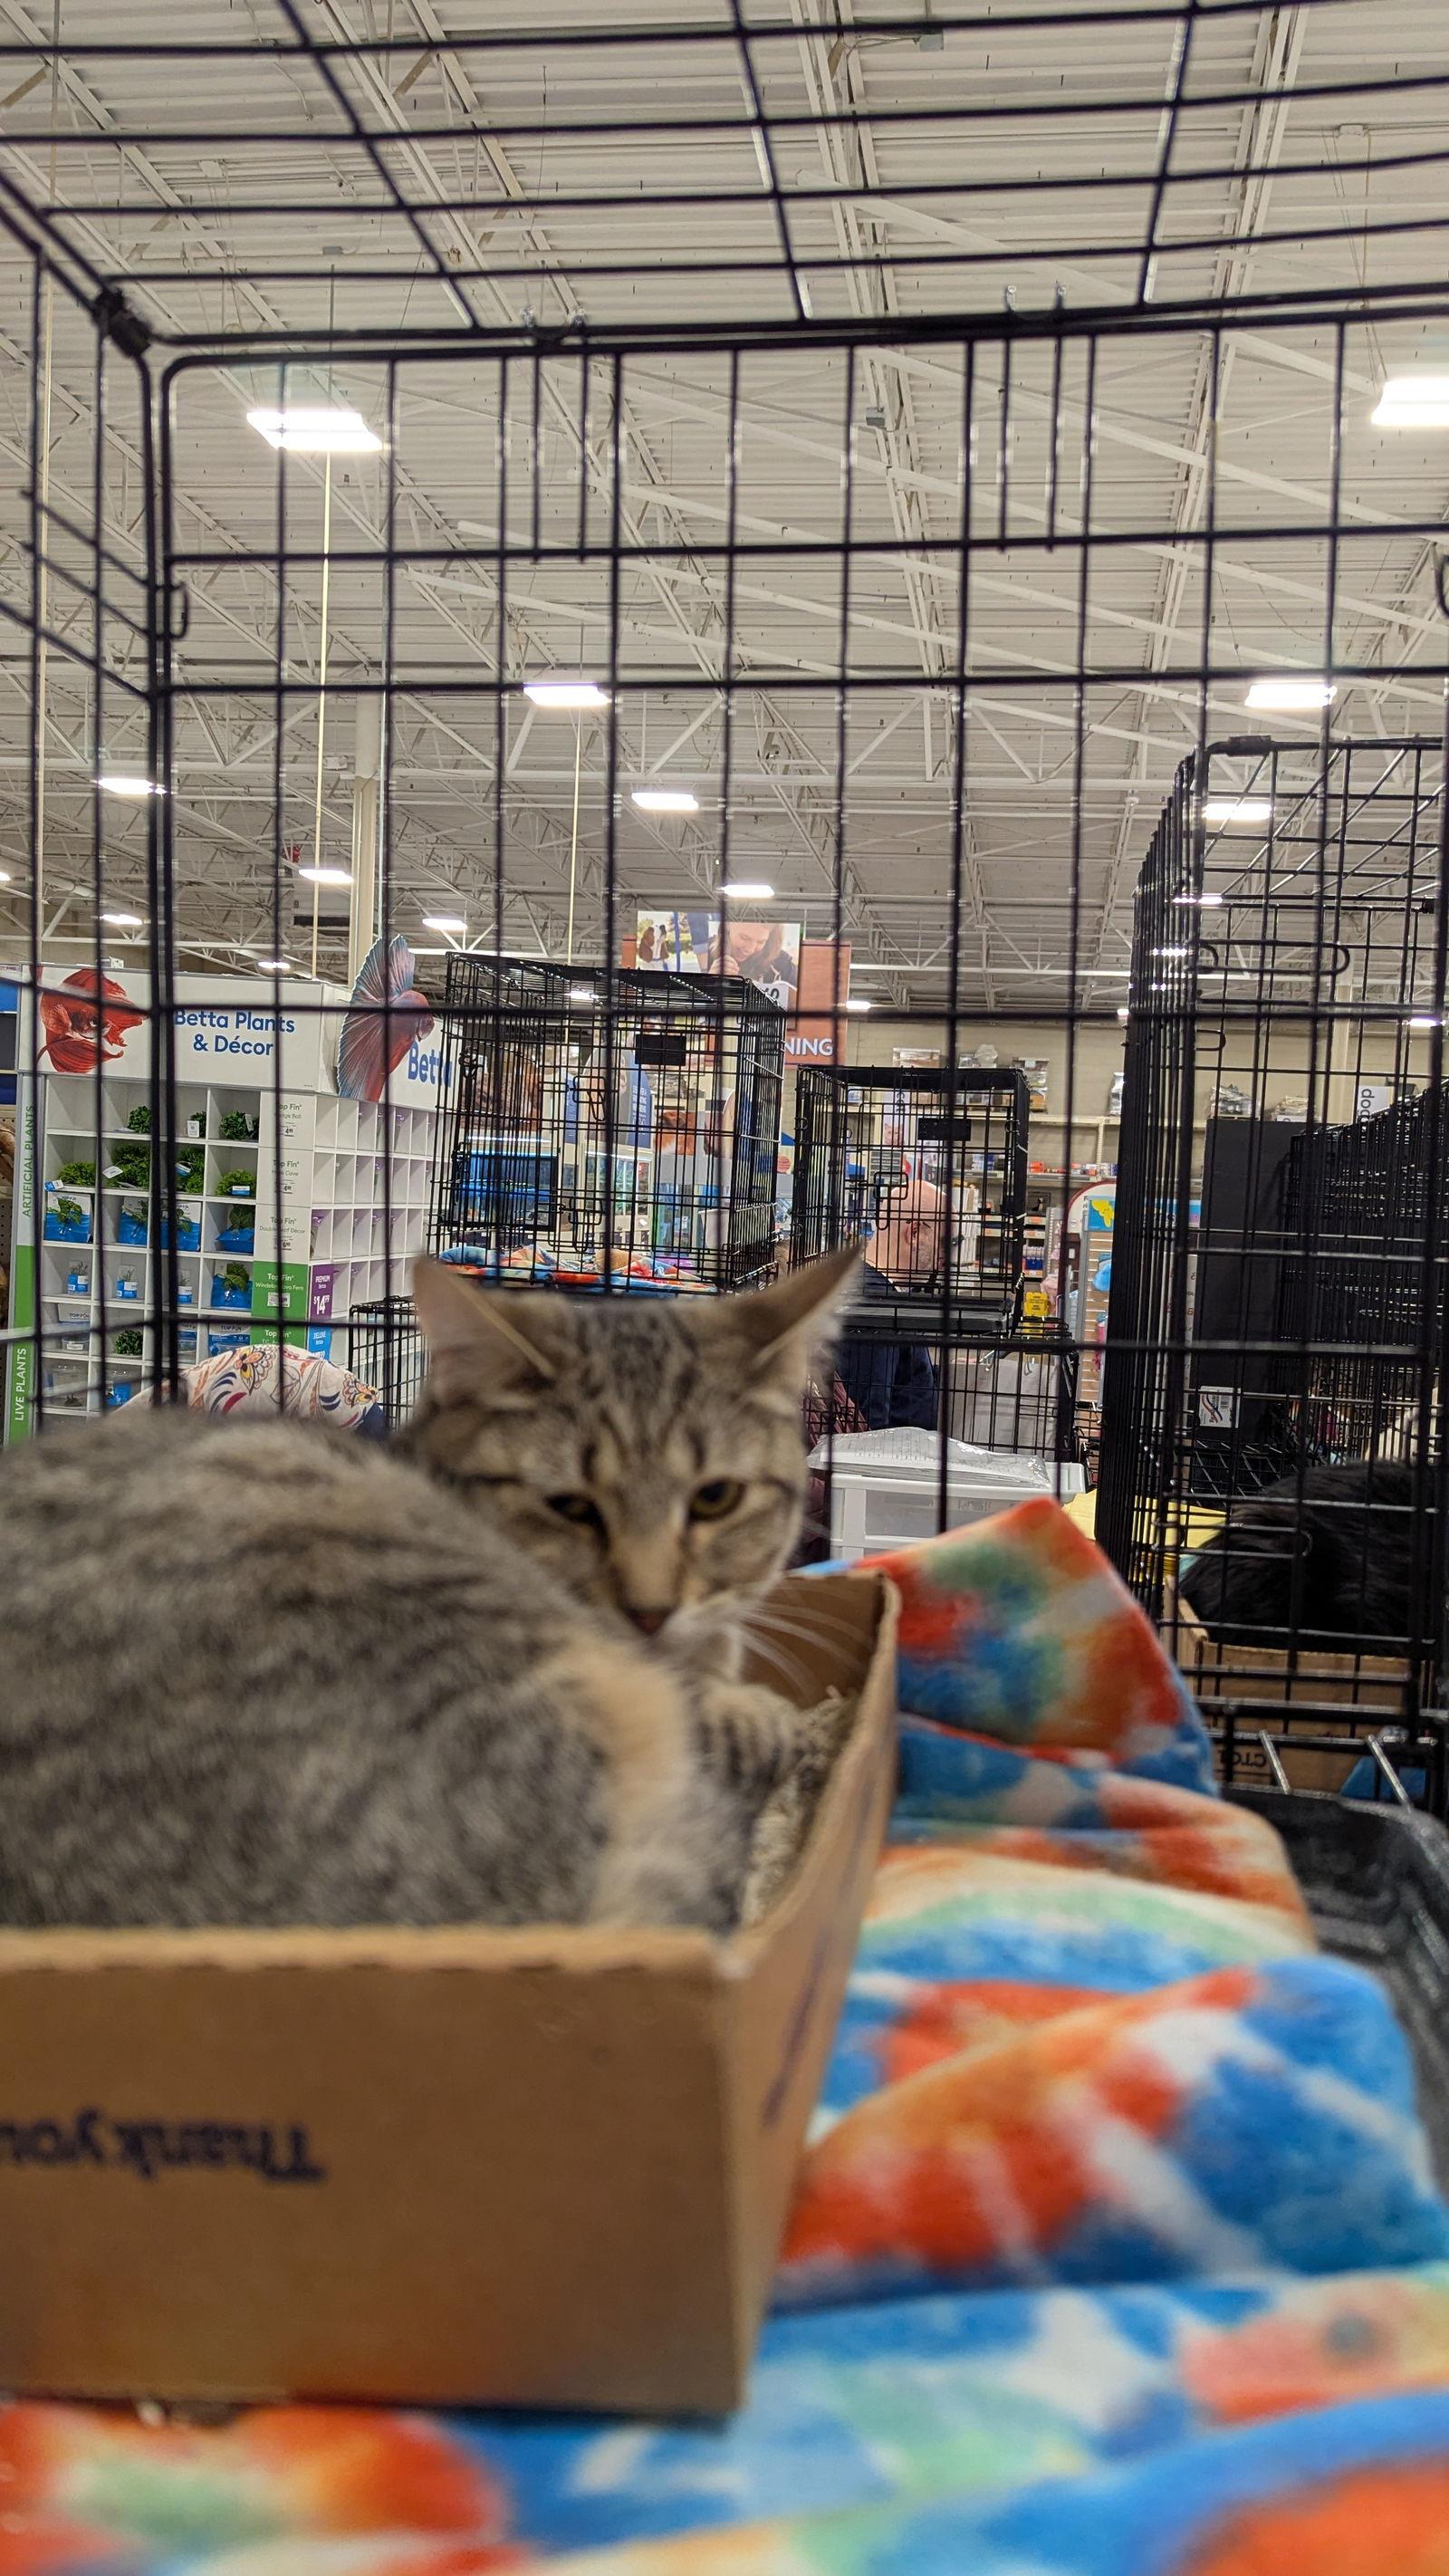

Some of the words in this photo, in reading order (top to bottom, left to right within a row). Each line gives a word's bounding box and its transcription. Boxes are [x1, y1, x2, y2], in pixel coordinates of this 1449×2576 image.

[174, 1009, 228, 1029] Betta
[235, 1011, 295, 1033] Plants
[193, 1033, 208, 1052] &
[214, 1035, 274, 1056] Décor
[24, 1105, 35, 1151] PLANTS
[22, 1152, 34, 1218] ARTIFICIAL
[15, 1348, 27, 1393] PLANTS
[14, 1396, 25, 1421] LIVE
[112, 2119, 329, 2184] Thank
